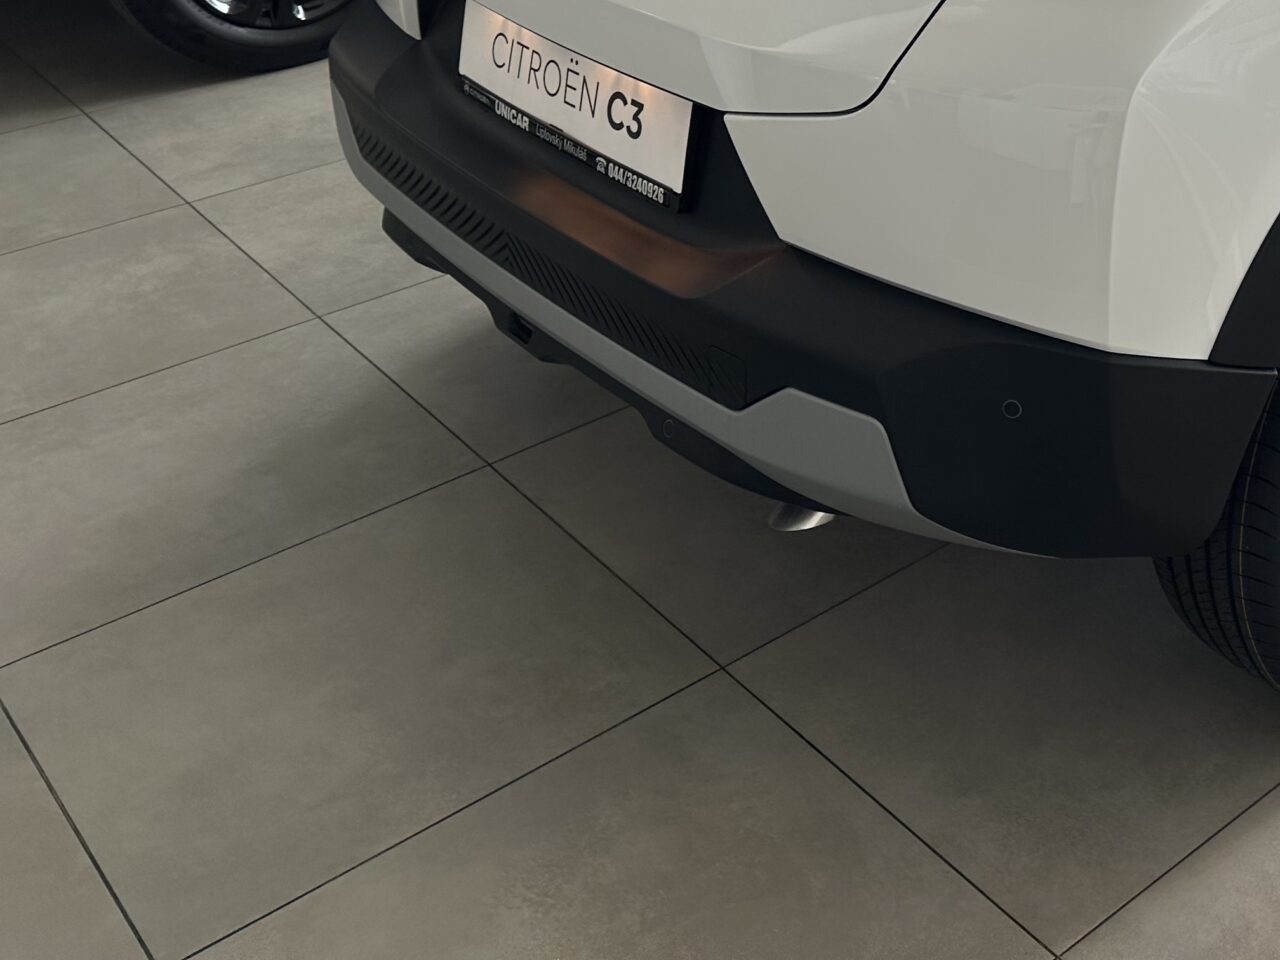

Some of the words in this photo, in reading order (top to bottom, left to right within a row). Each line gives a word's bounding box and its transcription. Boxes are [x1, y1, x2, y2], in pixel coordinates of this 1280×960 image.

[492, 32, 600, 119] CITROËN
[606, 91, 645, 140] C3
[495, 100, 529, 132] UNICAR
[607, 163, 665, 204] 044/3240926
